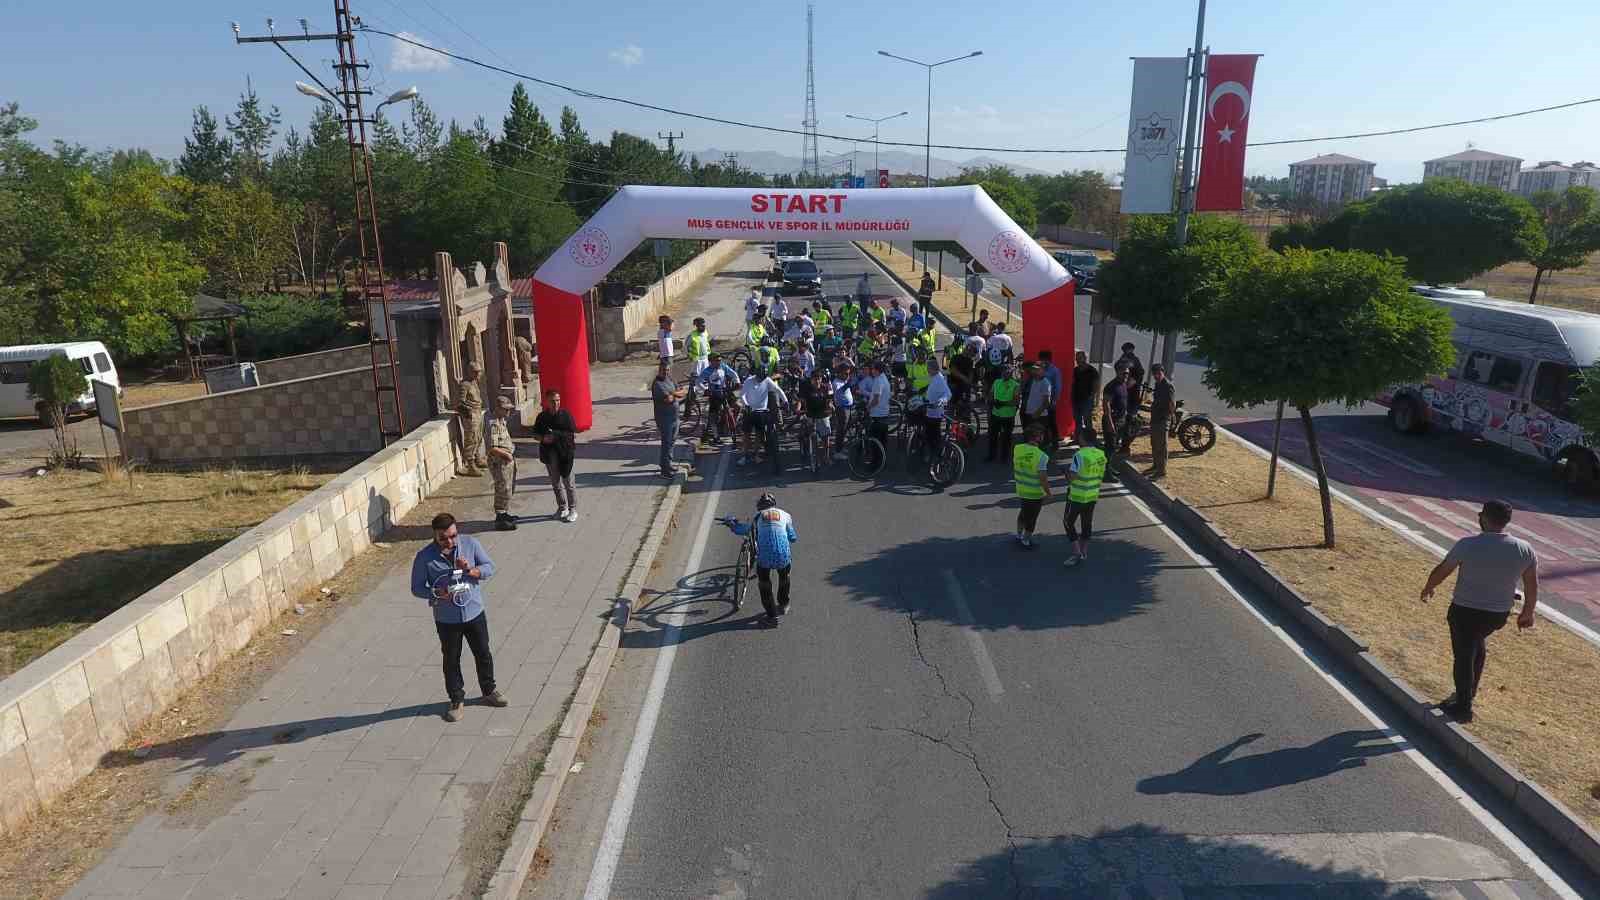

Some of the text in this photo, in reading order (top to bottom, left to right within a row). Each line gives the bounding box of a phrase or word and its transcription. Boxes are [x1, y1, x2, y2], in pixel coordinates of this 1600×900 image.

[751, 194, 848, 214] START
[715, 219, 765, 232] GENÇLİK
[768, 220, 784, 231] VE
[785, 221, 818, 231] SPOR
[821, 219, 833, 231] İL
[835, 218, 910, 231] MÜDÜRLÜĞÜ
